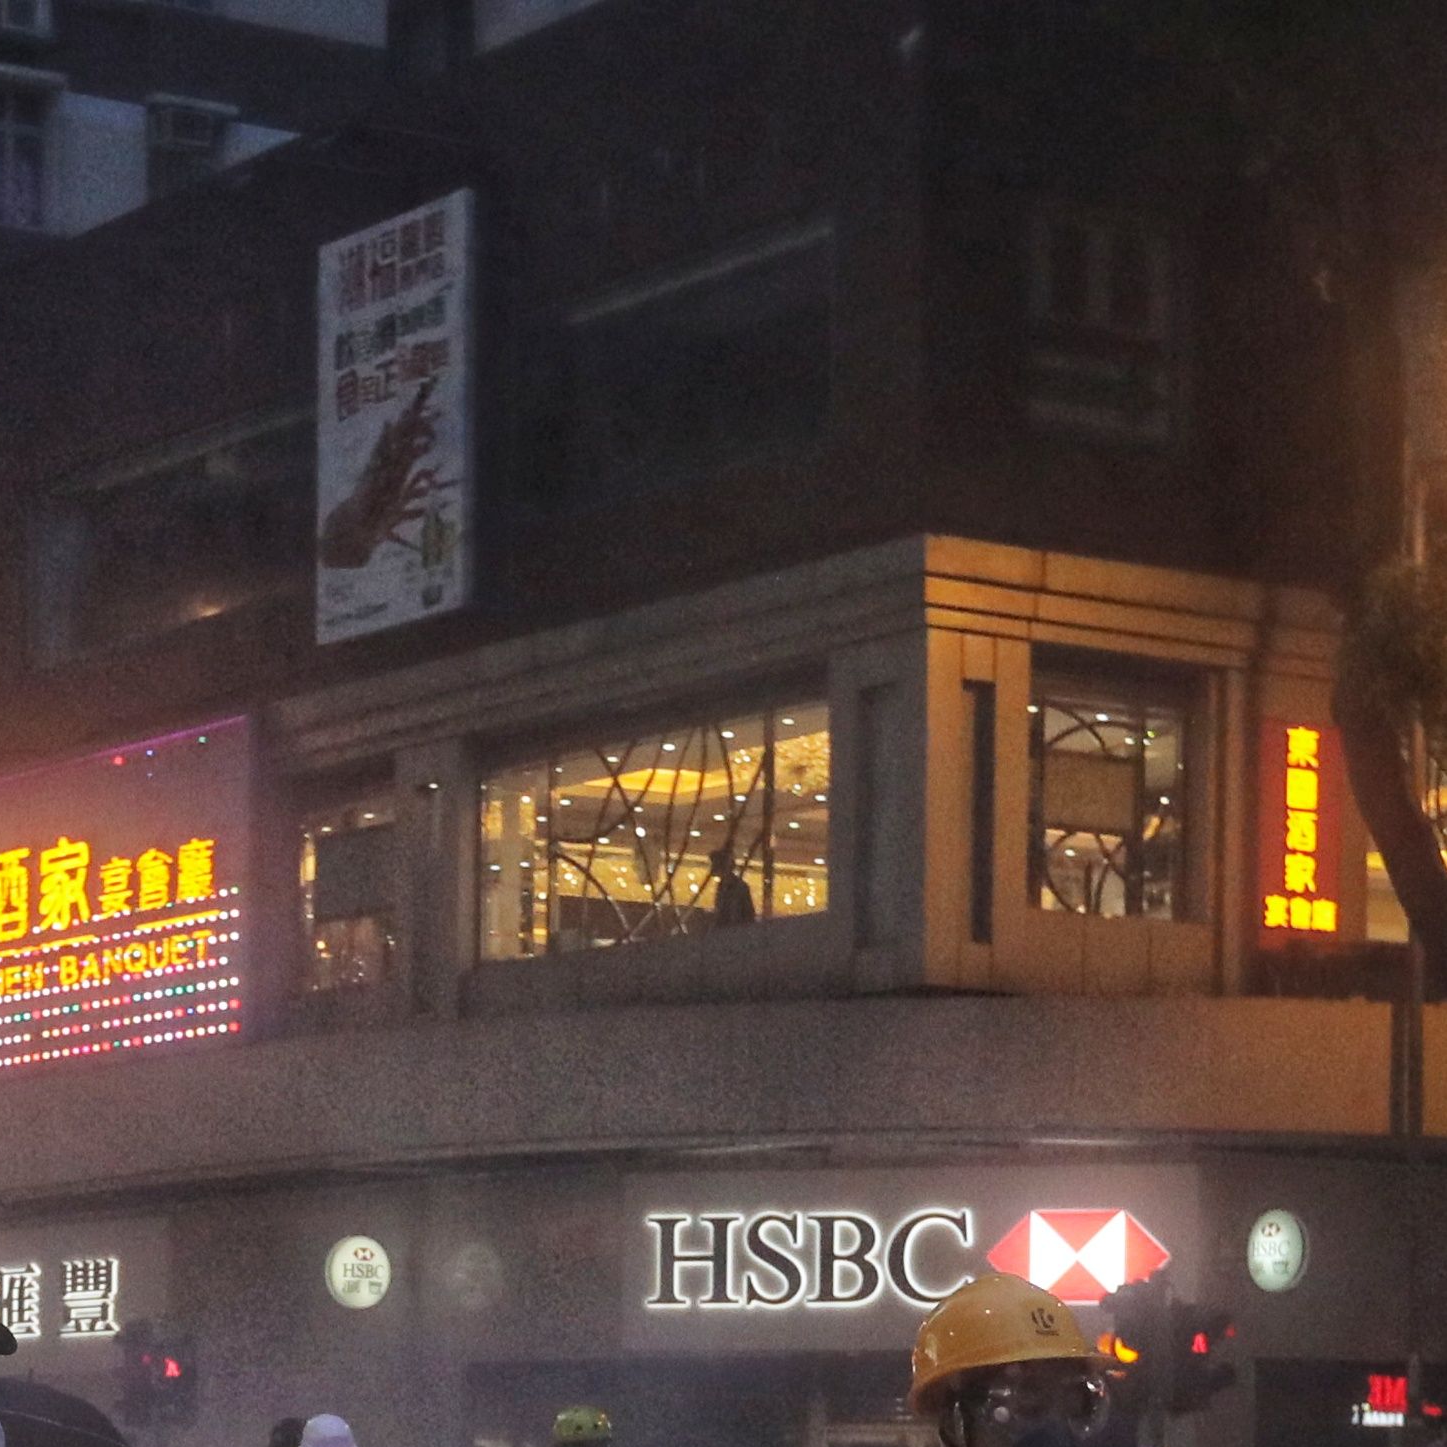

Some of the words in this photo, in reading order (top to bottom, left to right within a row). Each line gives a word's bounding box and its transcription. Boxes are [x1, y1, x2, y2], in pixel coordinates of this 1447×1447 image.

[60, 930, 214, 986] BANQUET
[343, 1263, 384, 1279] HSBC
[646, 1201, 975, 1311] HSBC
